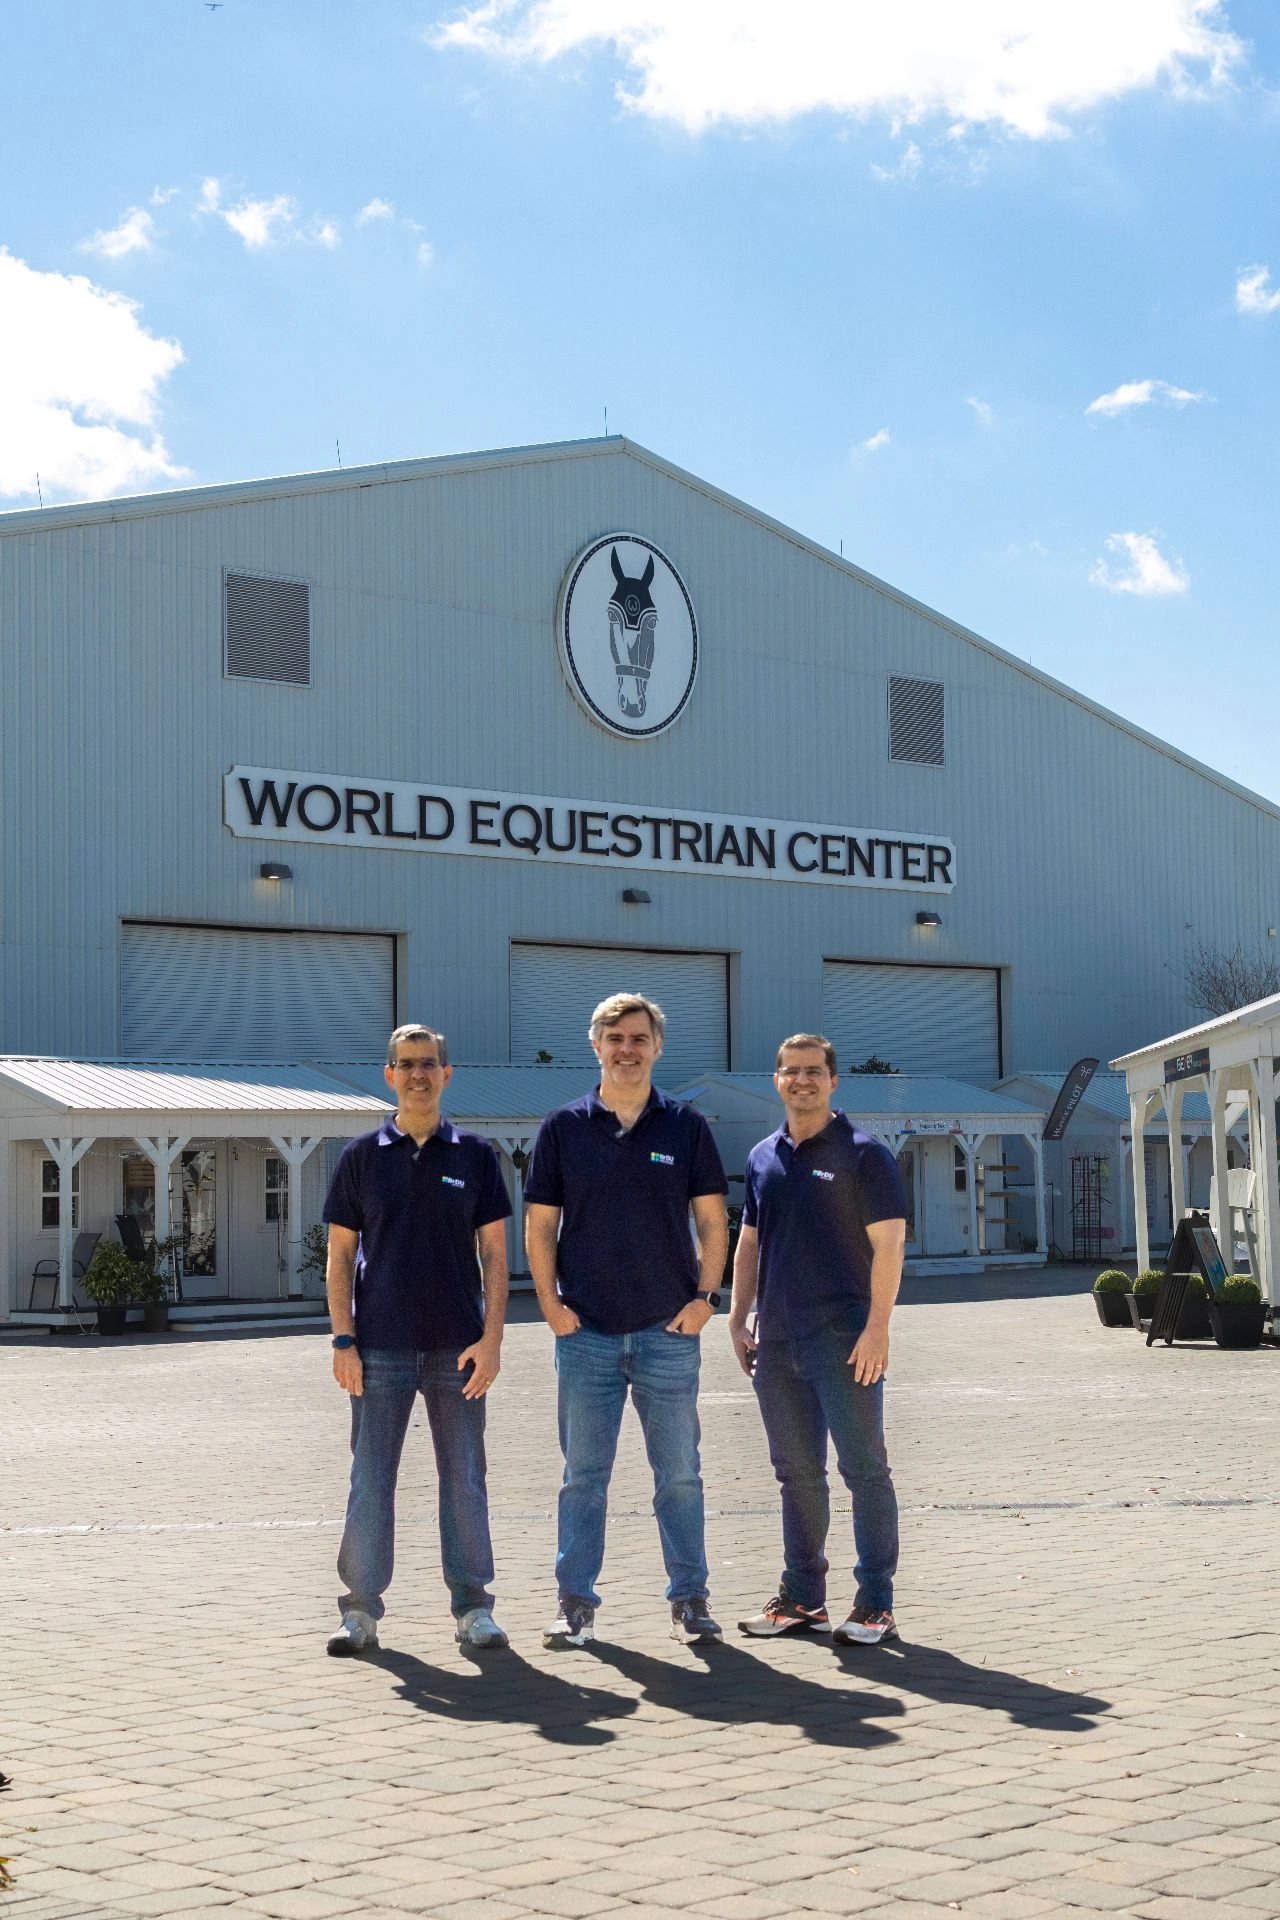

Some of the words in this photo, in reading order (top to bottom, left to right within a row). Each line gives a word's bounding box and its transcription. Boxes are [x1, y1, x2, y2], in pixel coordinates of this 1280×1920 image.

[239, 778, 455, 840] WORLD
[470, 801, 776, 868] EQUESTRIAN
[788, 832, 952, 883] CENTER
[1067, 1084, 1083, 1110] PILOT
